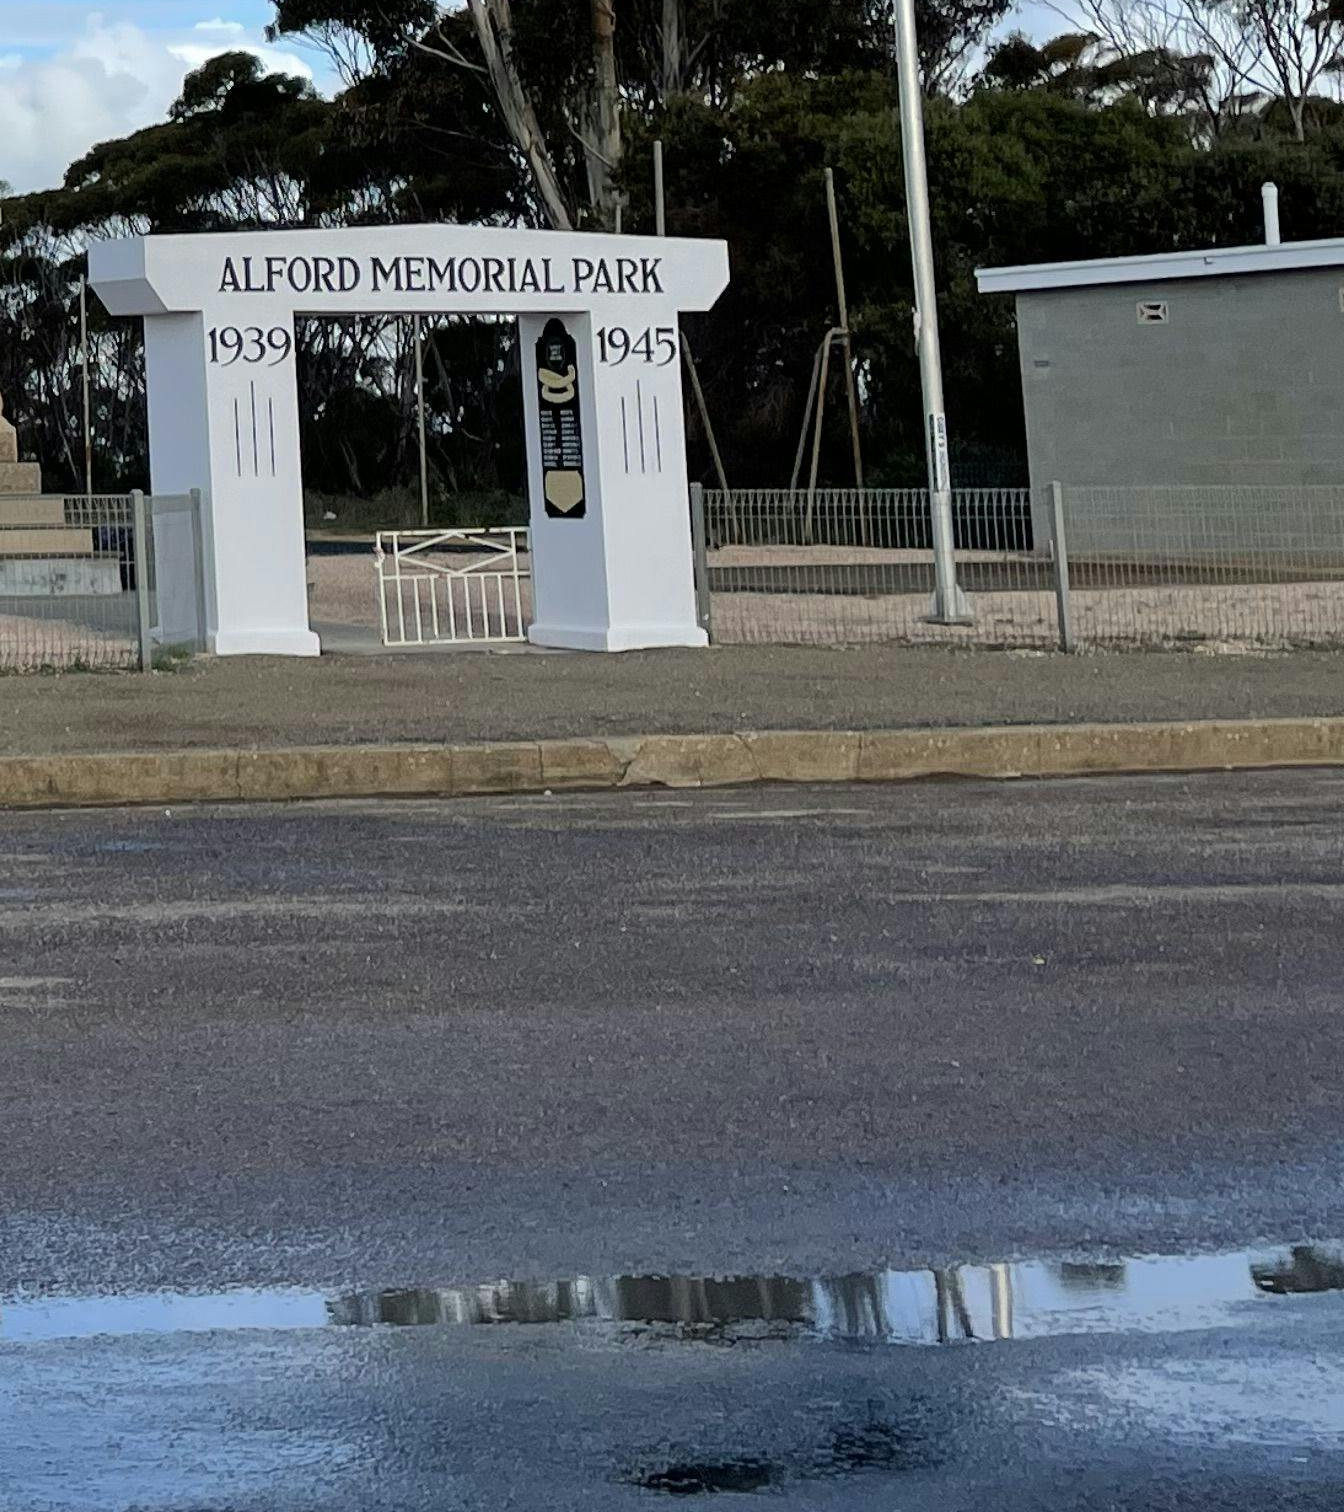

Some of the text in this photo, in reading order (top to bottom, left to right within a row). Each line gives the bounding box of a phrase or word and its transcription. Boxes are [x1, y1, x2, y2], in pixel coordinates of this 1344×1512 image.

[218, 256, 664, 293] ALFORD MEMORIAL PARK
[208, 326, 292, 367] 1939
[596, 326, 678, 367] 1945
